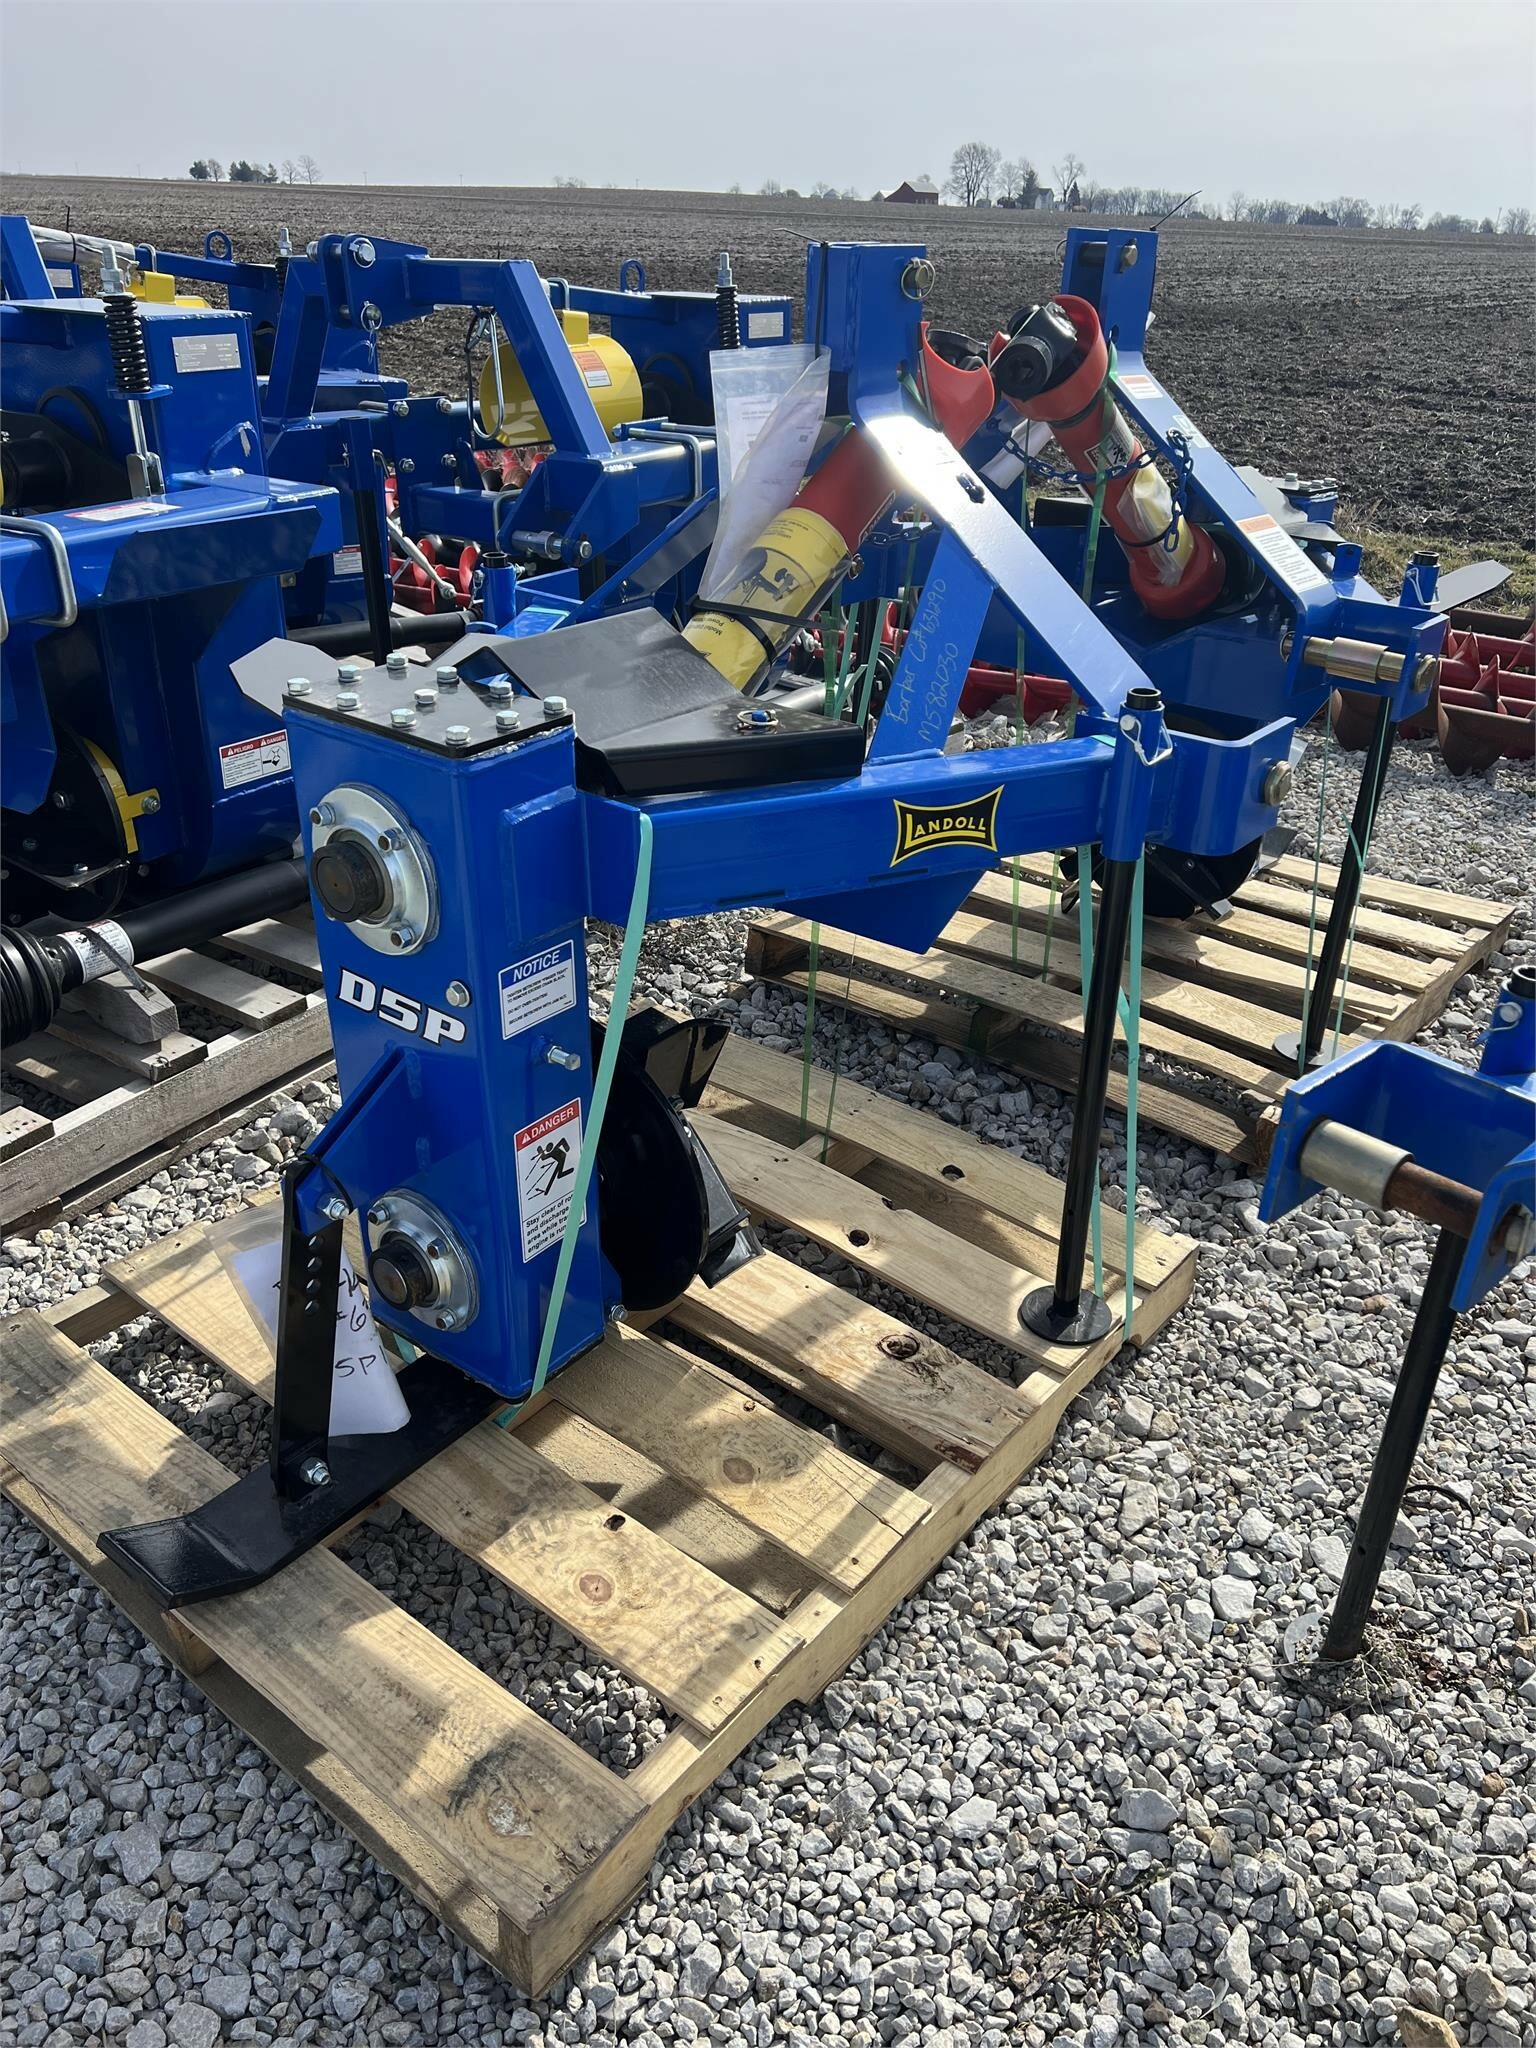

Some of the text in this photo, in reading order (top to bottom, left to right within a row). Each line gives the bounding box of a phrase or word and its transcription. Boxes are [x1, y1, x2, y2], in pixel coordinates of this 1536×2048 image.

[233, 744, 254, 754] PELIGRO
[904, 813, 986, 849] LANDOLL
[513, 950, 560, 982] NOTICE
[531, 1106, 574, 1139] DANGER
[525, 1214, 540, 1228] Stay
[540, 1204, 557, 1219] clear
[557, 1198, 564, 1208] of
[527, 1225, 539, 1237] and
[539, 1206, 570, 1230] discharge
[527, 1234, 541, 1246] area
[541, 1221, 558, 1238] while
[528, 1230, 556, 1254] engine is
